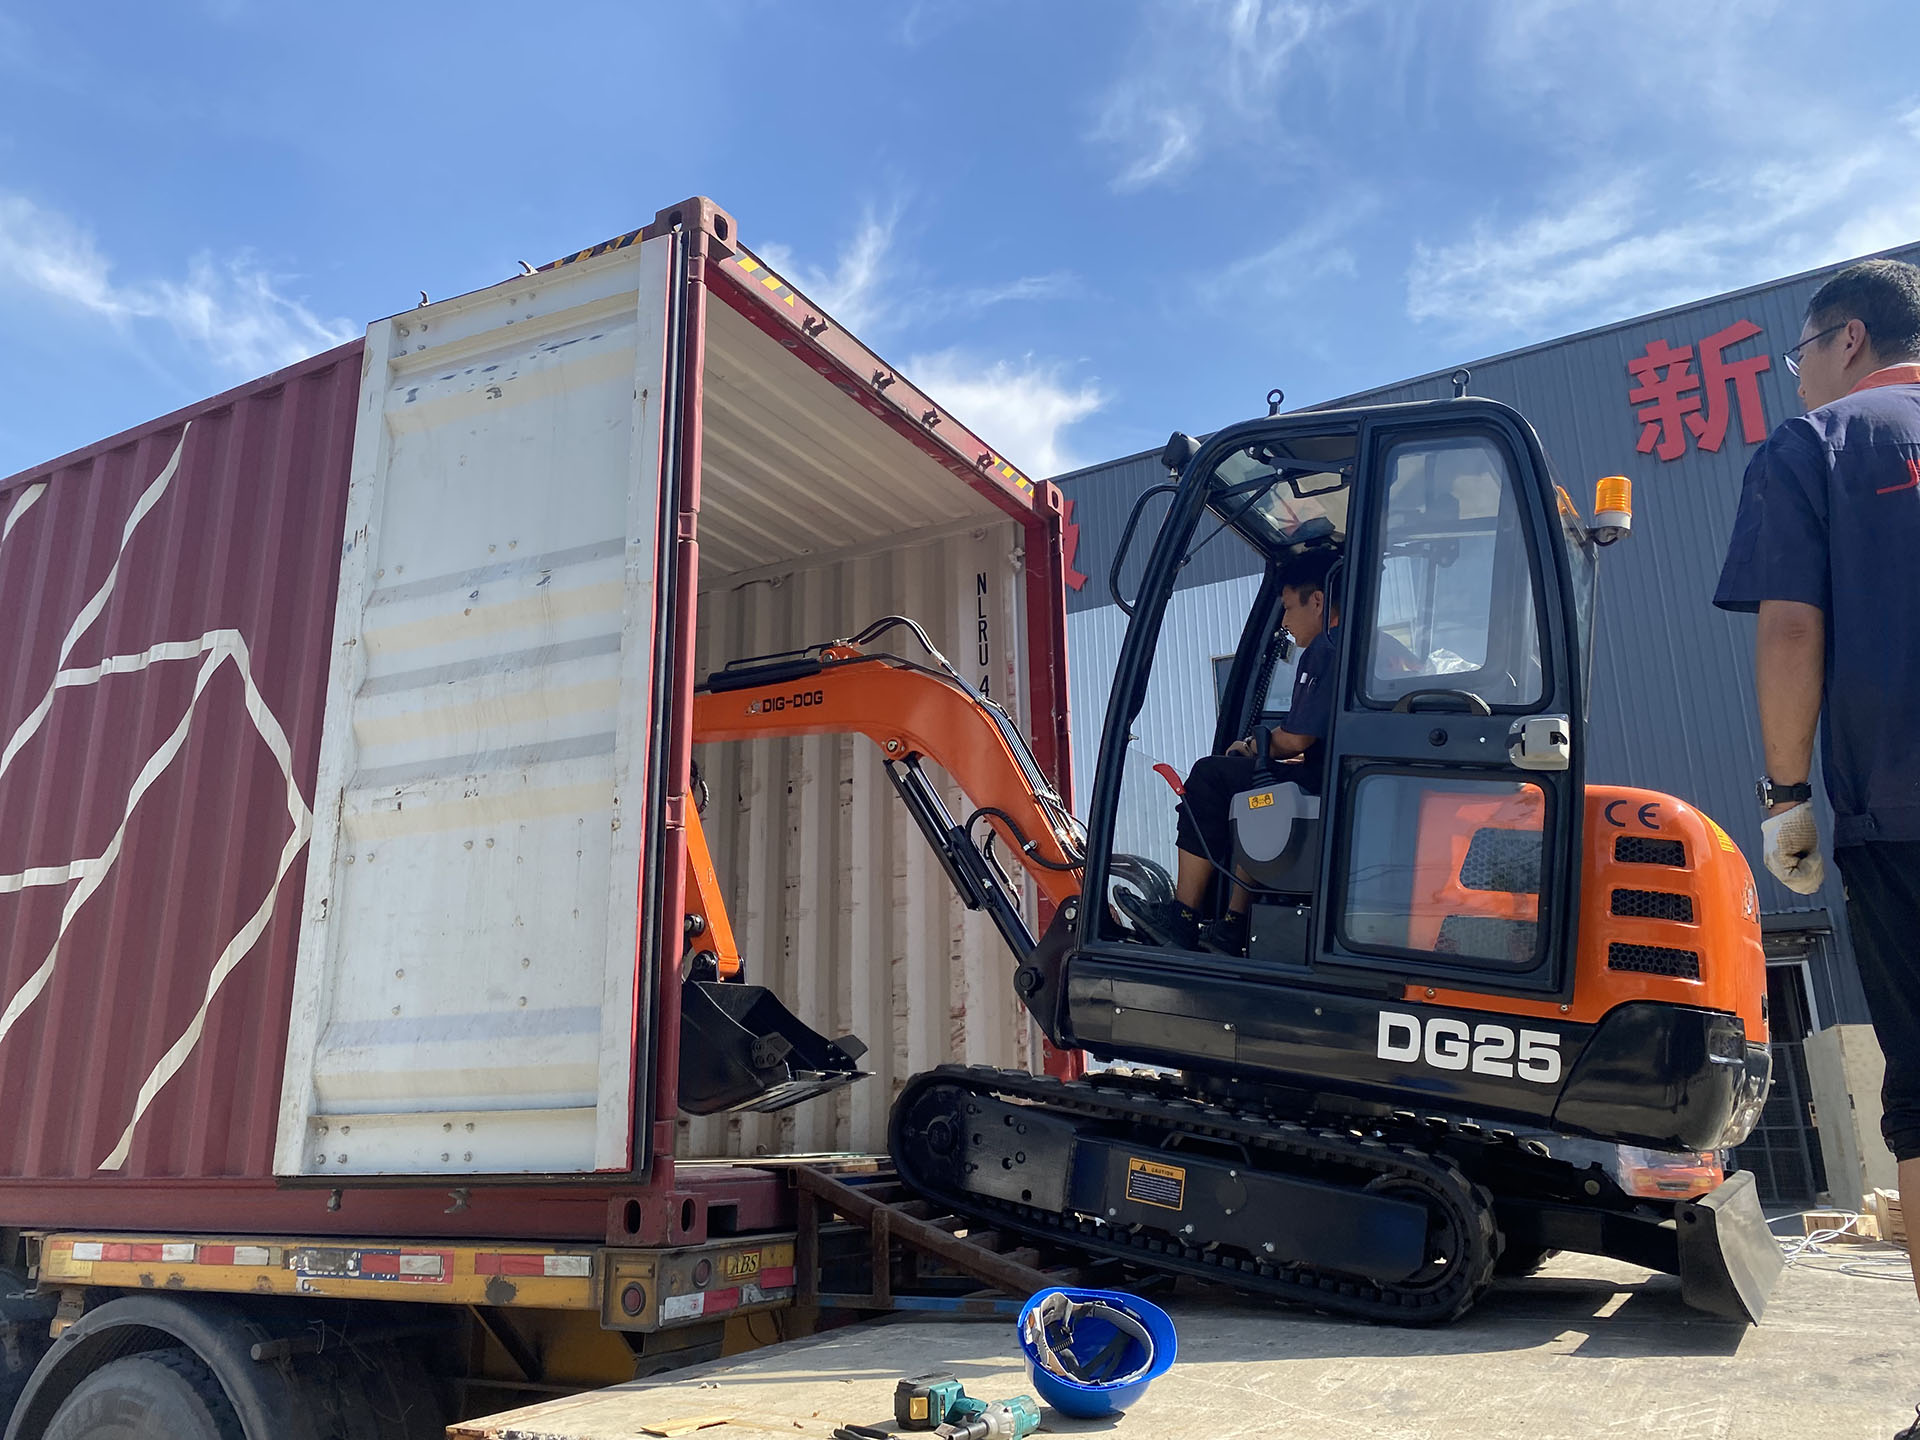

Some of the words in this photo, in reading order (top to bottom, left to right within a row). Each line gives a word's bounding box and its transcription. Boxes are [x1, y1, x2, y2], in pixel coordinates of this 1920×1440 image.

[1628, 319, 1771, 462] 新
[976, 571, 989, 666] NLRU
[762, 690, 823, 713] DIG-DOG
[1604, 800, 1661, 830] CE
[1377, 1010, 1562, 1084] DG25
[1151, 1167, 1174, 1177] CAUTION
[729, 1254, 758, 1275] ABS
